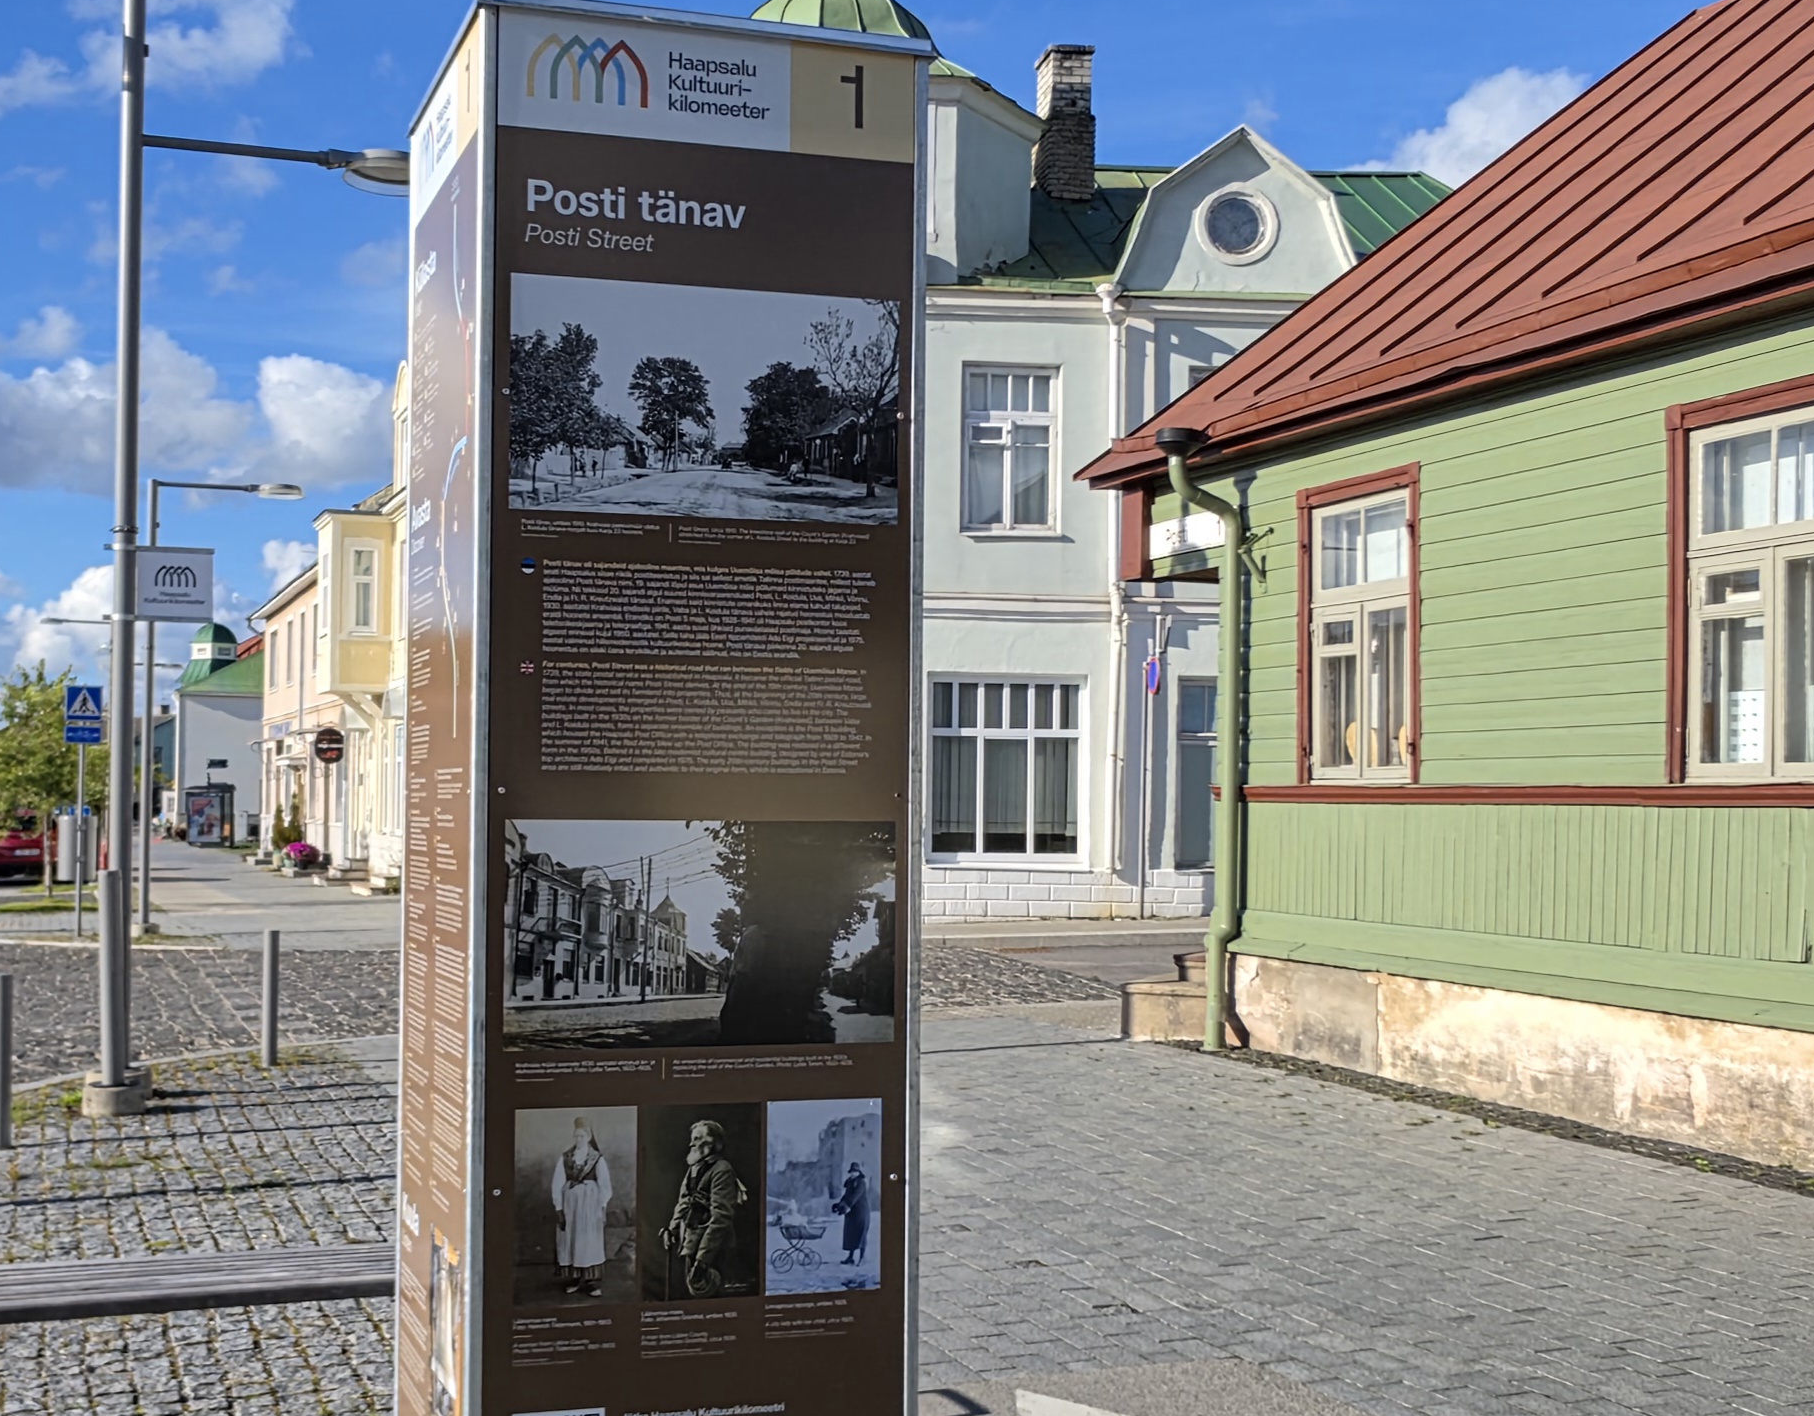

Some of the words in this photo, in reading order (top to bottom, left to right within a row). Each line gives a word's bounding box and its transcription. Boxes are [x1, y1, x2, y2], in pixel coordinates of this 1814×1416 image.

[669, 51, 757, 77] Haapsalu
[669, 73, 752, 96] Kultuuri-
[840, 65, 864, 129] 1
[668, 93, 771, 120] kilomeeter
[527, 178, 626, 219] Posti
[638, 190, 747, 229] tänav
[524, 223, 582, 247] Posti
[587, 228, 655, 252] Street
